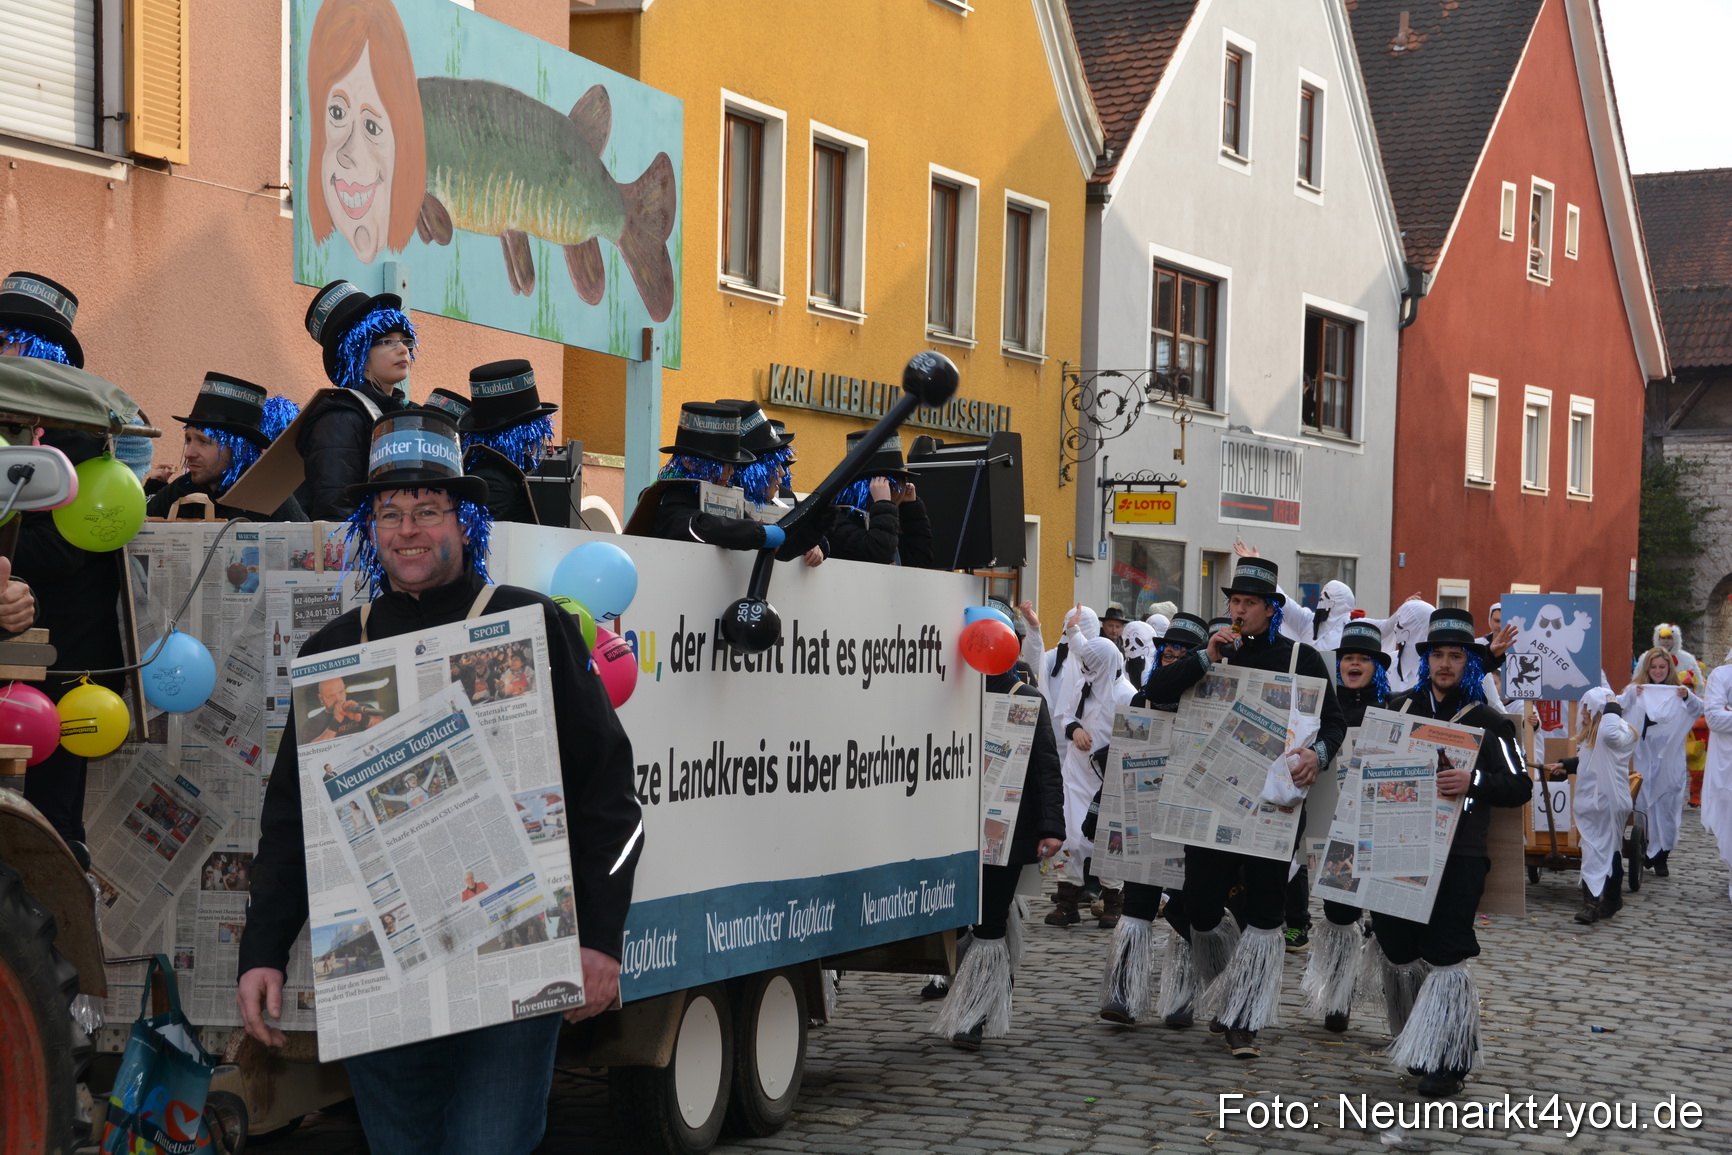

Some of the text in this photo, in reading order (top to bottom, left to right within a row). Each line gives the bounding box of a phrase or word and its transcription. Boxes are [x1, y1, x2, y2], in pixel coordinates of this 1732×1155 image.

[20, 280, 58, 305] Tagblatt
[212, 382, 258, 403] Neumarkter
[481, 379, 514, 395] Tagblatt
[770, 363, 816, 405] KARL
[821, 372, 902, 417] LIEBLEIN
[692, 416, 736, 430] Neumarkter
[1221, 440, 1303, 501] FRISEUR TEAM
[1134, 500, 1172, 511] LOTTO
[1273, 499, 1300, 525] KREBS
[306, 606, 340, 618] 24.01.2015
[737, 602, 749, 622] 250
[750, 604, 762, 622] KG
[474, 624, 506, 639] SPORT
[670, 614, 706, 674] der
[791, 619, 830, 676] hat
[836, 638, 857, 677] es
[861, 623, 946, 690] geschafft,
[1530, 639, 1570, 671] ABSTIEG
[319, 663, 327, 671] IN
[328, 656, 357, 669] BAYERN
[226, 677, 243, 687] WSV
[1512, 689, 1535, 697] 1859
[498, 708, 538, 723] Massenchor
[512, 702, 528, 711] zum
[1237, 704, 1269, 728] Neumarkter
[335, 720, 459, 793] Neumarkter Tagblatt
[1126, 757, 1159, 768] Neumarkter
[633, 762, 662, 806] ze
[668, 738, 778, 803] Landkreis
[786, 739, 842, 794] über
[845, 735, 920, 797] Berching
[1367, 766, 1430, 778] Neumarkter Tagblatt
[385, 830, 411, 848] Scharfe
[411, 819, 430, 834] Kritik
[431, 815, 439, 824] an
[439, 793, 480, 819] CSU-Vorstoß
[551, 875, 563, 884] der
[706, 905, 785, 954] Neumarkter
[787, 898, 836, 943] Tagblatt
[860, 884, 918, 927] Neumarkter
[919, 878, 956, 918] Tagblatt
[337, 982, 347, 991] für
[348, 980, 360, 988] den
[361, 973, 390, 985] Tsunami,
[547, 985, 566, 995] Großer
[317, 985, 381, 1004] 2004 den Tod brachte
